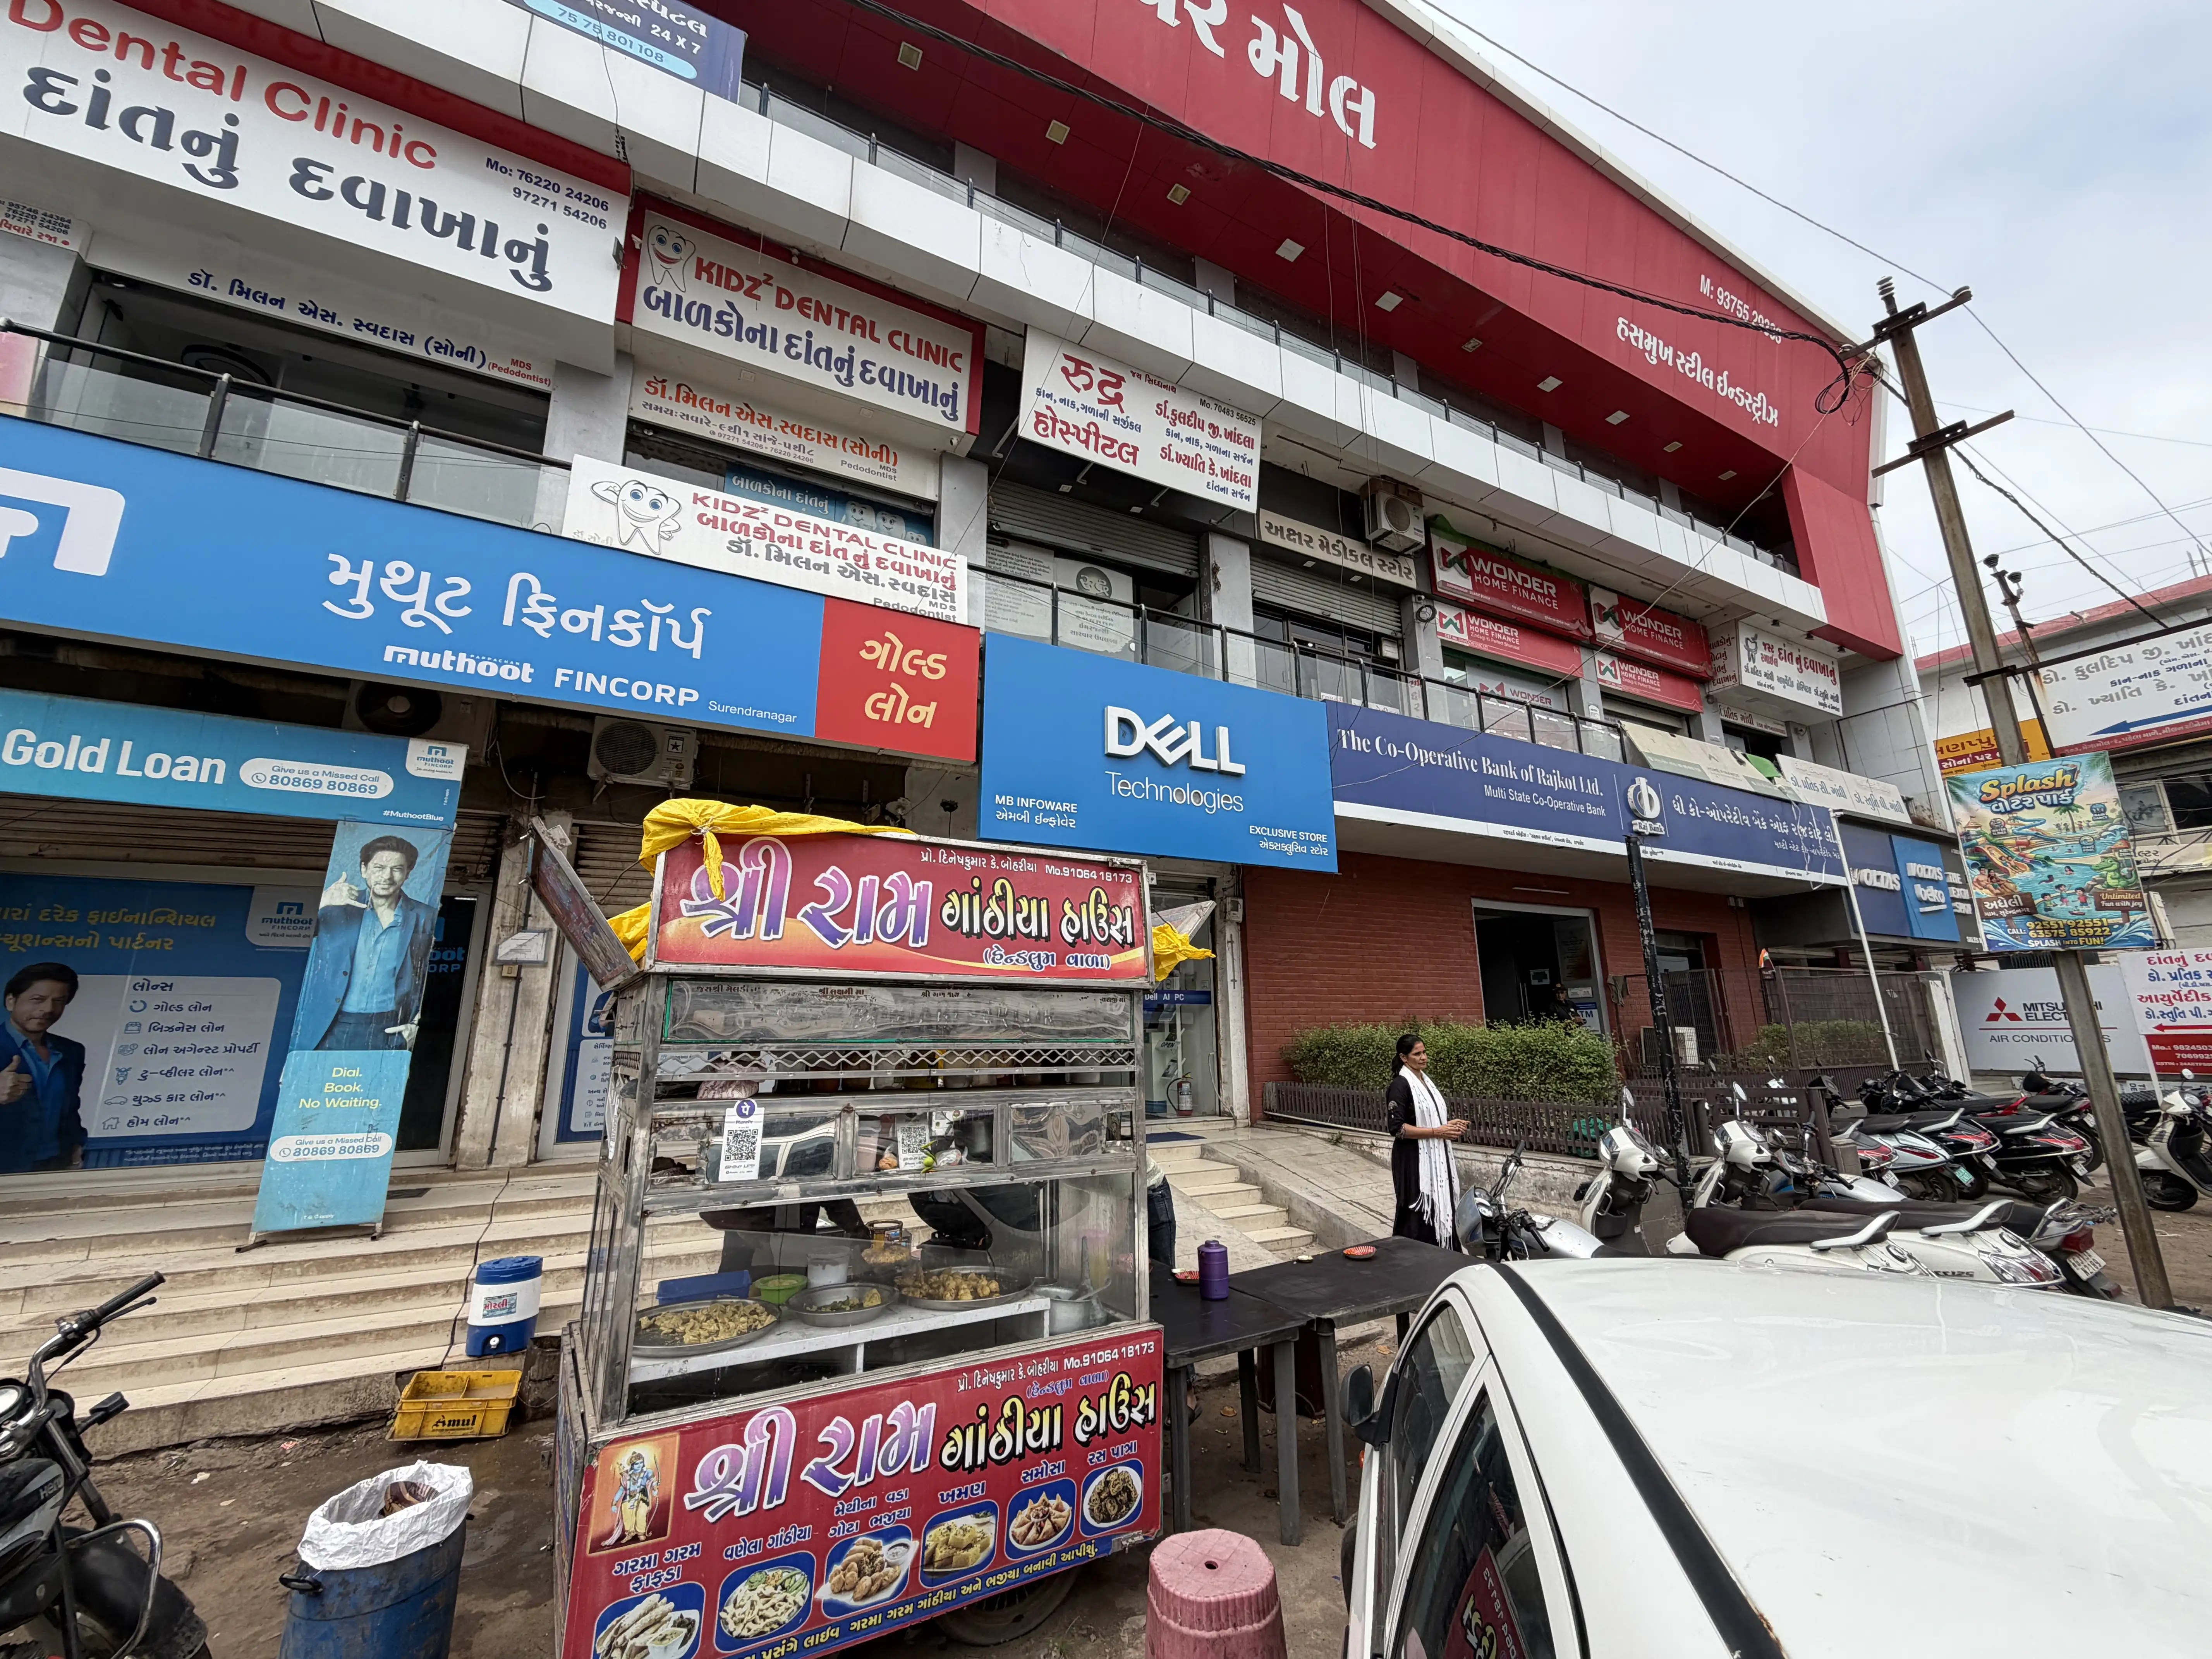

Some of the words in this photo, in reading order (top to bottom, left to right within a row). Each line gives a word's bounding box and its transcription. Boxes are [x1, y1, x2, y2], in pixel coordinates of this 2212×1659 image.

[558, 7, 578, 24] 75
[691, 42, 701, 55] 7
[8, 0, 247, 102] Dental
[264, 82, 438, 169] Clinic
[23, 67, 240, 189] દાંતનું
[289, 157, 552, 292] દવાખાનું
[517, 169, 560, 194] 76220
[565, 187, 609, 212] 24206
[512, 187, 557, 212] 97271
[563, 204, 607, 229] 54206
[1717, 287, 1749, 322] 93755
[228, 278, 285, 310] મિલન
[353, 318, 414, 346] સ્વદાસ
[424, 335, 486, 369] (સોની)
[775, 286, 881, 344] DENTAL
[888, 329, 963, 373] CLINIC
[1617, 317, 1673, 365] હસમુખ
[1676, 352, 1714, 390] સ્ટીલ
[488, 361, 551, 386] (Pedodontist)
[511, 358, 532, 371] MDS
[1130, 370, 1142, 381] જય
[1214, 403, 1234, 418] 70483
[1236, 412, 1256, 426] 56525
[718, 432, 740, 443] 97271
[742, 438, 763, 450] 54206
[793, 453, 814, 464] 24206
[1205, 442, 1231, 459] ગળાના
[879, 465, 897, 474] MDS
[1206, 480, 1228, 495] દાંતના
[775, 514, 877, 550] DENTAL
[883, 543, 957, 569] CLINIC
[1264, 520, 1314, 550] અક્ષર
[1470, 555, 1557, 598] WONDER
[322, 553, 472, 635] મુથૂટ
[1474, 573, 1508, 592] HOME
[1512, 584, 1559, 610] FINANCE
[928, 601, 957, 612] MDS
[1467, 614, 1519, 638] WONDER
[1621, 609, 1682, 640] WONDER
[1469, 625, 1489, 636] HOME
[1491, 632, 1520, 646] FINANCE
[1625, 623, 1648, 637] HOME
[1651, 631, 1684, 650] FINANCE
[859, 631, 948, 680] ગોલ્ડ
[1619, 661, 1659, 681] WONDER
[2075, 653, 2134, 681] કુલદિપ
[383, 645, 534, 684] muthoot
[554, 668, 699, 706] FINCORP
[708, 700, 797, 725] Surendranagar
[1621, 670, 1636, 680] HOME
[1637, 675, 1661, 687] FINANCE
[864, 683, 936, 729] લોન
[1104, 706, 1246, 776] DELL
[2, 728, 111, 773] Gold
[115, 741, 226, 784] Loan
[417, 756, 454, 765] muthoot
[272, 765, 296, 775] Give
[297, 768, 310, 776] us
[322, 769, 357, 780] Missed
[360, 772, 380, 783] Call
[1482, 756, 1518, 780] Bank
[269, 773, 323, 789] 80869
[327, 779, 378, 795] 80869
[1105, 771, 1244, 815] Technologies
[1980, 769, 2077, 803] Splash
[995, 795, 1014, 806] MB
[1017, 797, 1077, 813] INFOWARE
[1484, 784, 1506, 800] Multi
[1508, 788, 1531, 804] State
[1586, 803, 1606, 817] Bank
[383, 810, 444, 821] #MuthootBlue
[996, 810, 1031, 825] એમબી
[1249, 825, 1297, 840] EXCLUSIVE
[1299, 831, 1328, 843] STORE
[1638, 821, 1649, 835] Raj
[1649, 822, 1663, 833] Bank
[1099, 871, 1132, 883] 18173
[2100, 892, 2142, 902] Unlimited
[39, 904, 79, 923] દરેક
[798, 866, 933, 949] રામ
[261, 917, 313, 926] muthoot
[2026, 919, 2064, 930] 92551
[2066, 918, 2109, 928] 92551
[2028, 928, 2067, 939] 63575
[2069, 927, 2112, 937] 85922
[2028, 939, 2061, 948] SPLASH
[2079, 936, 2105, 946] FUN!
[2147, 953, 2189, 967] દાંતનું
[2167, 967, 2202, 981] પ્રતિક
[132, 979, 174, 992] લોન્સ
[154, 1000, 184, 1013] ગોલ્ડ
[188, 1001, 212, 1013] લોન
[148, 1021, 196, 1033] બિઝનેસ
[200, 1022, 225, 1033] લોન
[143, 1043, 168, 1055] લોન
[332, 1067, 363, 1079] Dial.
[324, 1082, 364, 1093] Book.
[166, 1093, 185, 1103] કાર
[299, 1097, 321, 1109] No
[325, 1096, 382, 1110] Waiting.
[126, 1114, 149, 1128] હોમ
[293, 1146, 336, 1157] 80869
[338, 1143, 380, 1156] 80869
[295, 1138, 313, 1147] Give
[335, 1137, 364, 1146] Missed
[1121, 1342, 1154, 1358] 18173
[432, 1415, 477, 1428] Amul
[684, 1405, 797, 1524] શ્રી
[801, 1400, 938, 1497] રામ
[939, 1395, 1063, 1474] ગાંઠીયા
[1073, 1371, 1156, 1447] હાઉસ
[1087, 1449, 1106, 1465] રસ
[885, 1487, 909, 1504] વડા
[612, 1552, 659, 1577] ગરમા
[663, 1542, 702, 1565] ગરમ
[630, 1565, 682, 1593] ફાફડા
[803, 1626, 840, 1648] લાઈવ
